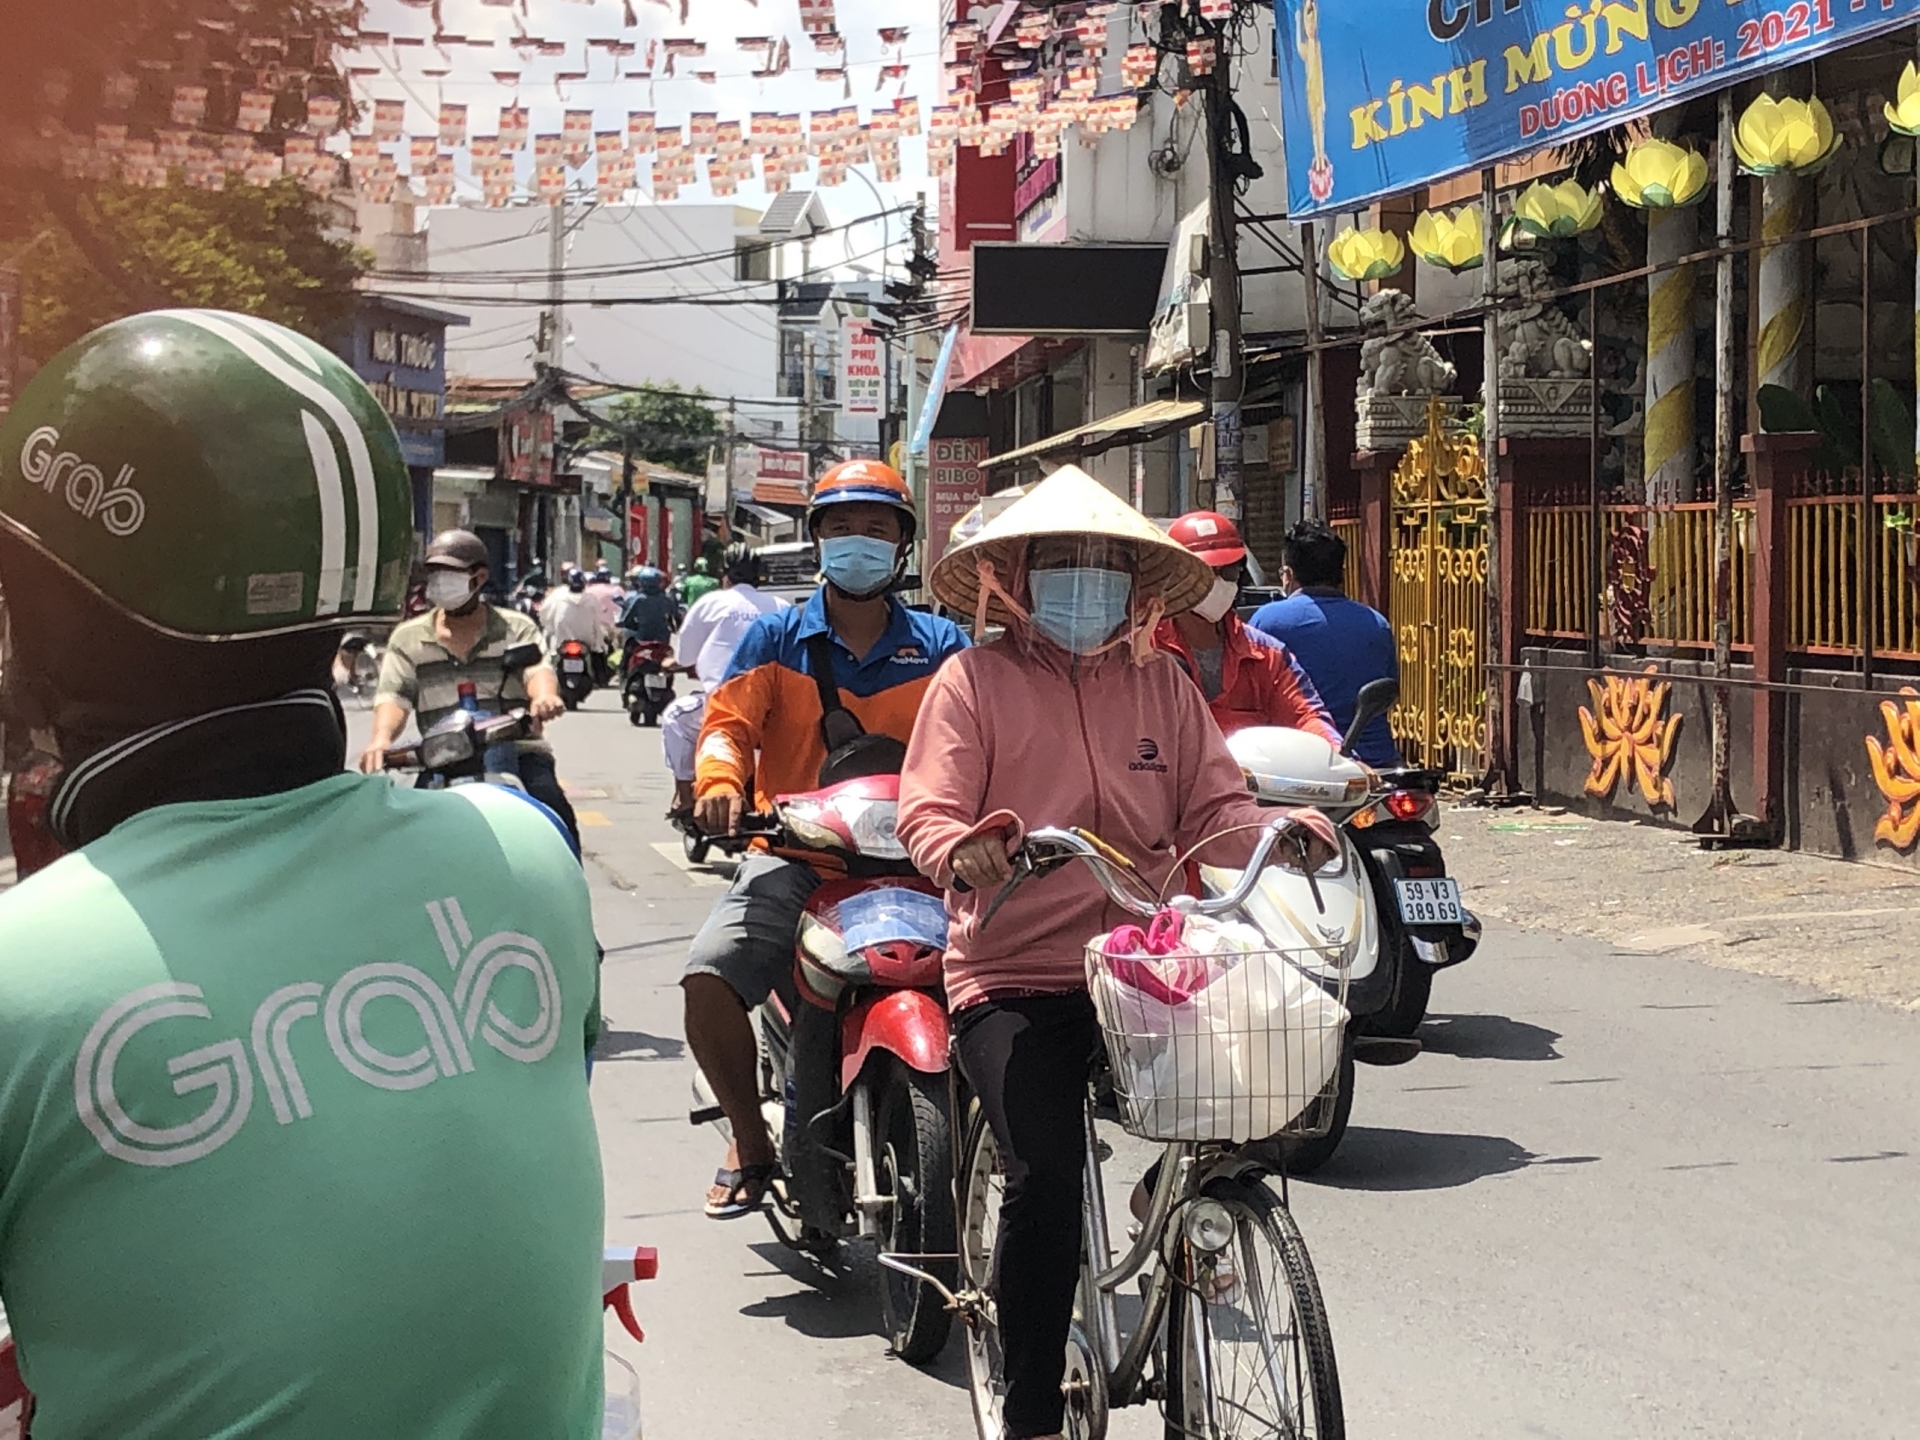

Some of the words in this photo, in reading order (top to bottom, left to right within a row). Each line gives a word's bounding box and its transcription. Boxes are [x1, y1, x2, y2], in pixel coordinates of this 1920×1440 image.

[1519, 72, 1628, 139] DƯƠNG
[1636, 36, 1725, 97] LỊCH:
[1737, 0, 1835, 62] 2021
[1349, 60, 1488, 150] KÍNH
[851, 349, 876, 362] PHỤ
[847, 365, 880, 376] KHOA
[20, 425, 146, 536] Grab
[935, 466, 981, 485] BIBO
[1405, 881, 1450, 901] 59-V3
[1405, 901, 1458, 921] 389.69
[74, 897, 562, 1167] Grab
